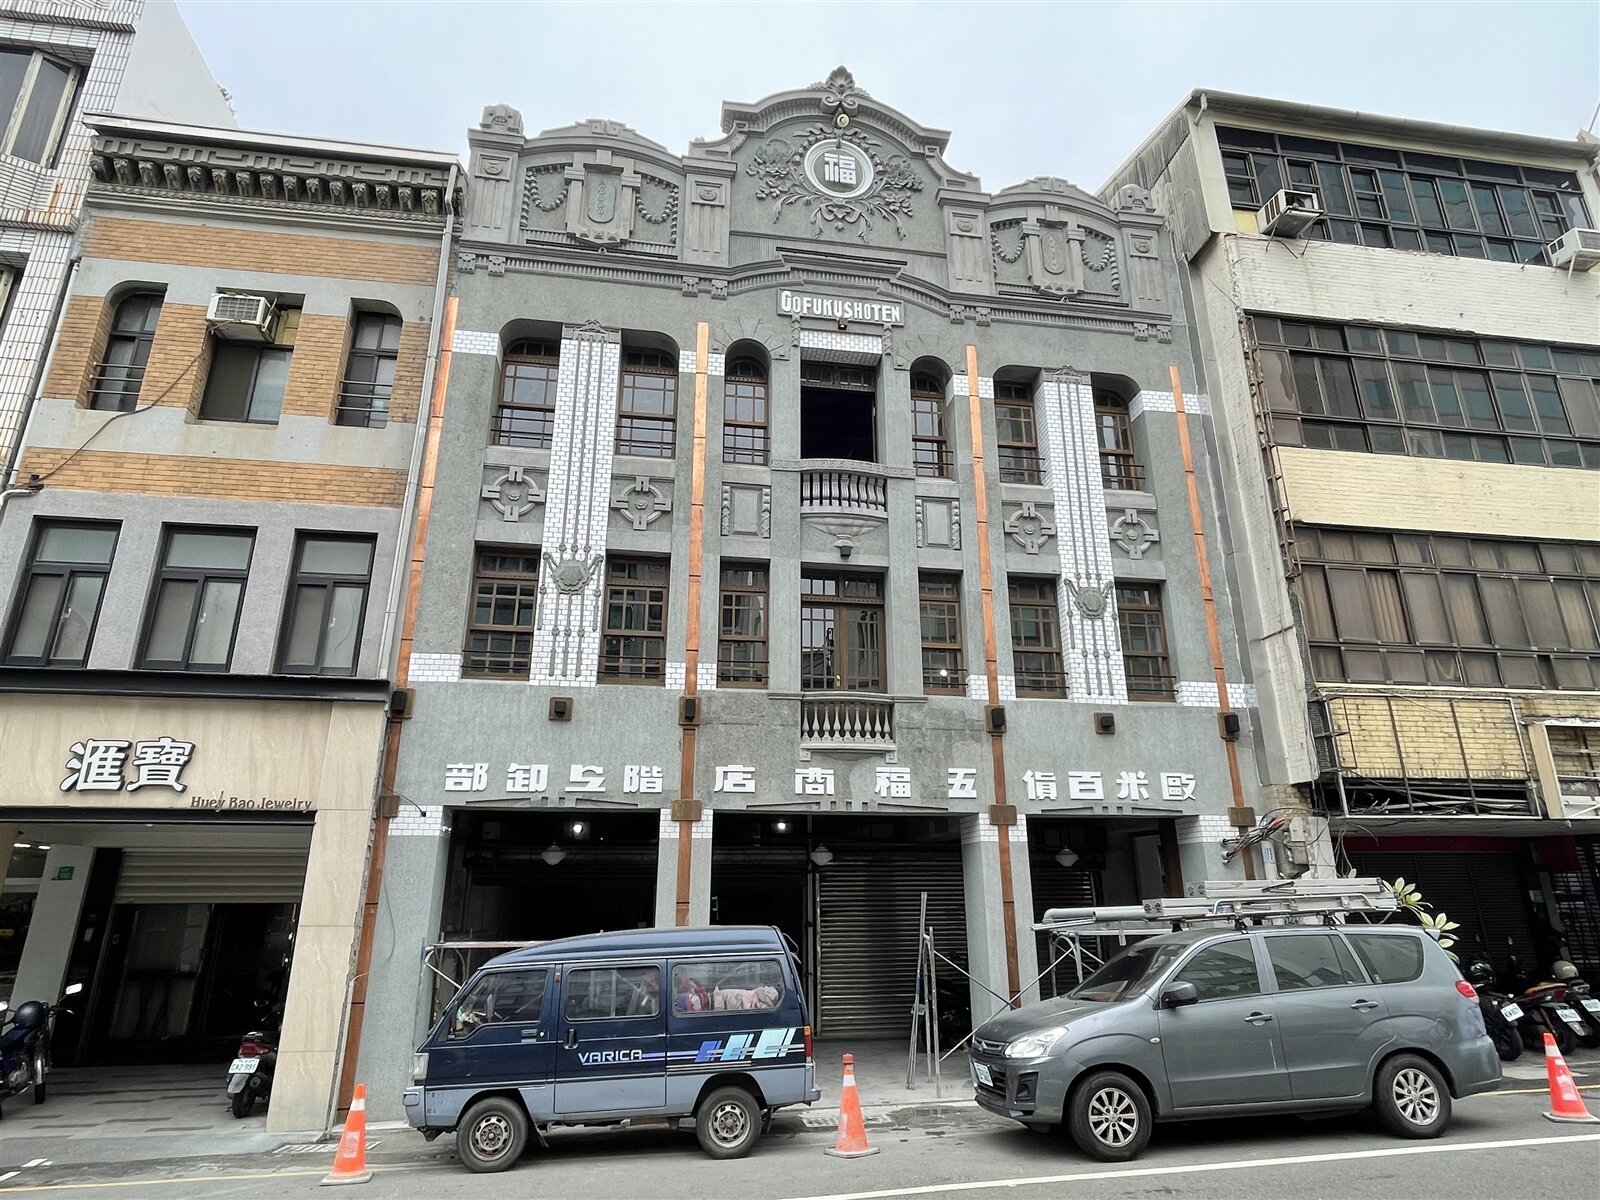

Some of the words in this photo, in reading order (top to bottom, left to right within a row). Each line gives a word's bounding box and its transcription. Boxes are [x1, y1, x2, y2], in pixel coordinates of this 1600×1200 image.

[824, 152, 857, 185] 福
[781, 290, 901, 323] GOFUKUSHOTEN
[190, 796, 226, 811] Huey
[228, 797, 256, 809] Bao
[257, 797, 313, 812] Jewelry
[578, 1049, 643, 1063] VARICA
